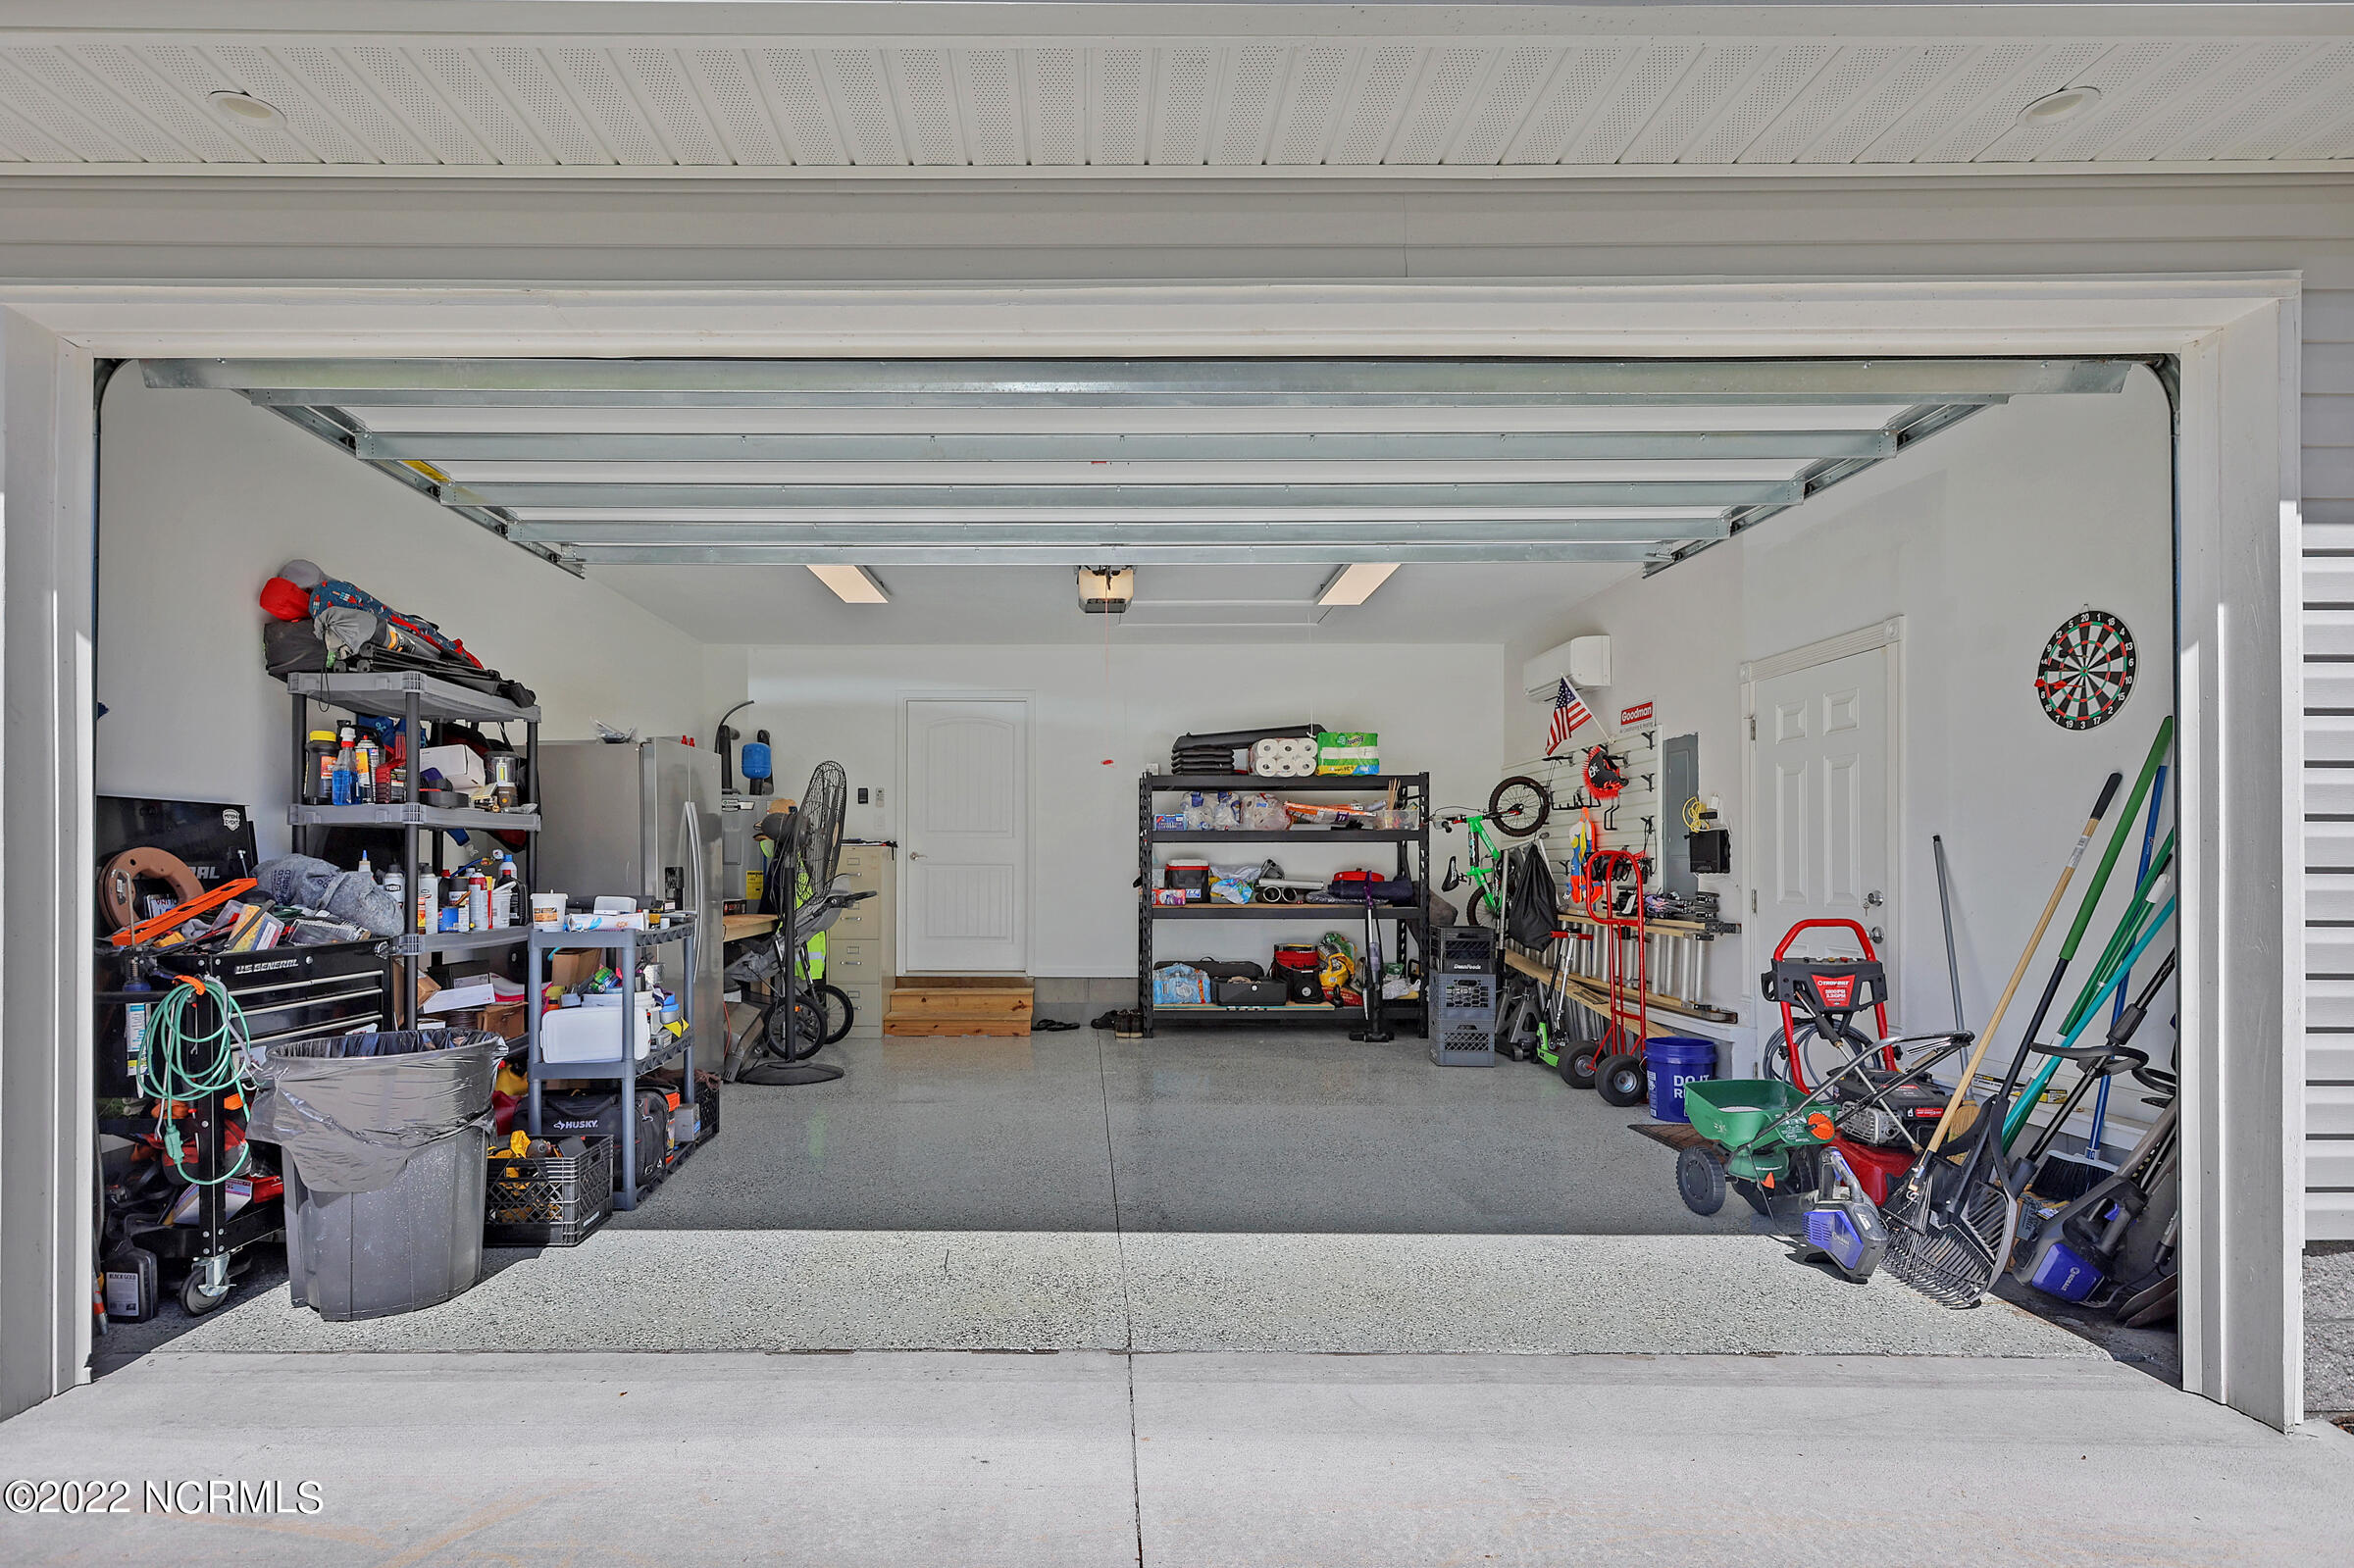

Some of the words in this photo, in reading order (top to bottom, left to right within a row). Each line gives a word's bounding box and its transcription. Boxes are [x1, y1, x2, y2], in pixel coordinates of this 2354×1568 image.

[2080, 613, 2090, 622] 20
[2069, 620, 2073, 629] 5
[2055, 630, 2063, 639] 12
[2120, 627, 2125, 636] 4
[2124, 641, 2133, 651] 13
[2128, 658, 2134, 667] 6
[2124, 676, 2132, 684] 10
[2118, 692, 2125, 701] 15
[1621, 706, 1652, 722] Goodman
[2107, 706, 2114, 715] 2
[2066, 720, 2073, 729] 19
[2092, 716, 2102, 725] 17
[2080, 721, 2086, 730] 3
[253, 959, 298, 972] GENERAL
[565, 1120, 598, 1129] HUSKY
